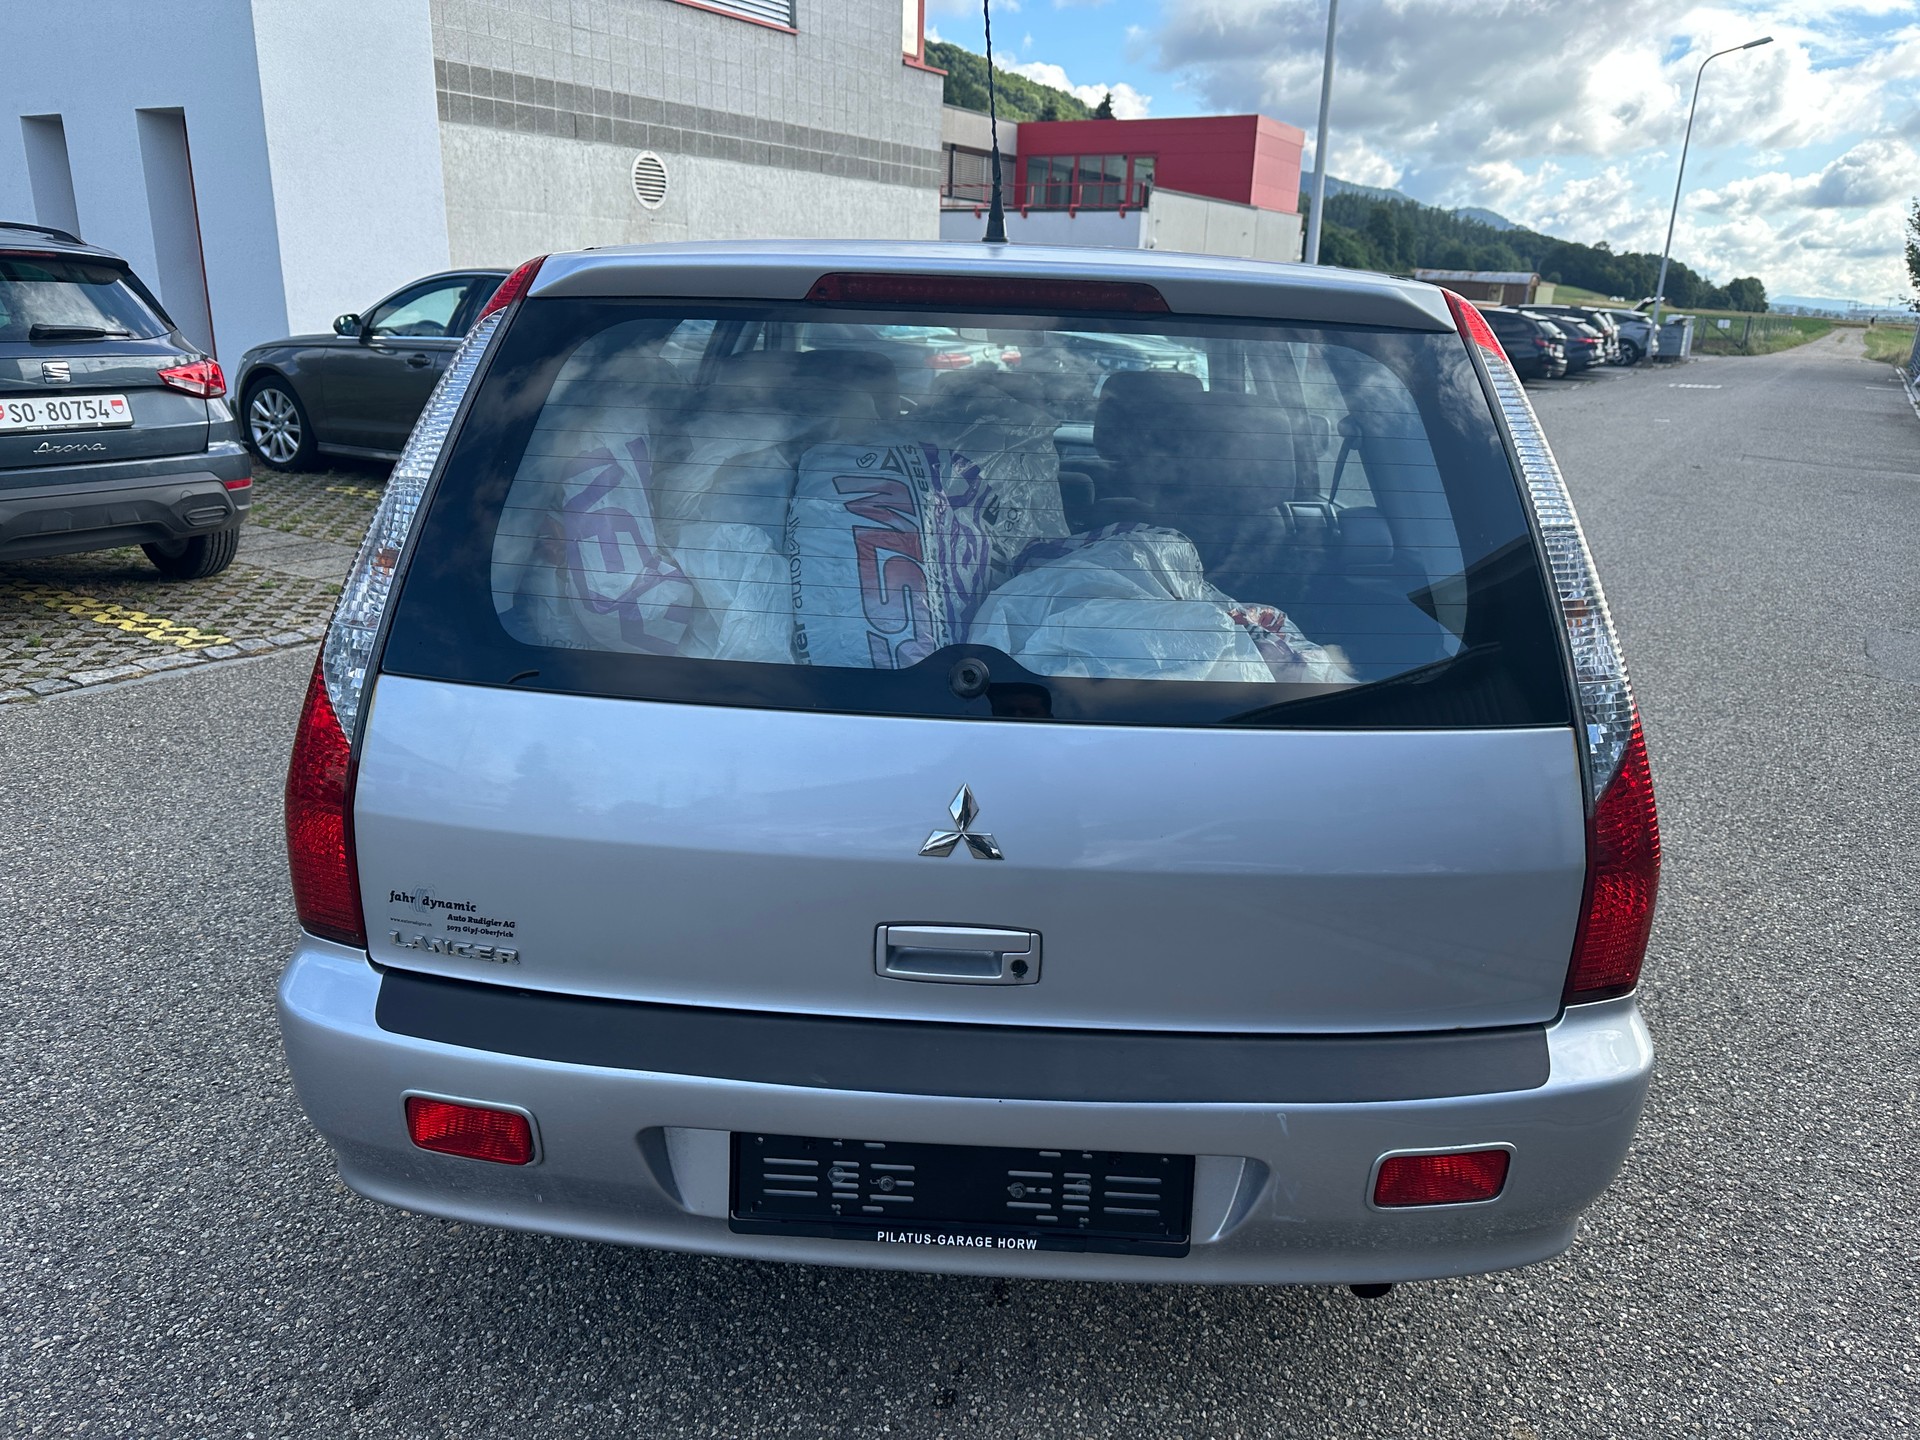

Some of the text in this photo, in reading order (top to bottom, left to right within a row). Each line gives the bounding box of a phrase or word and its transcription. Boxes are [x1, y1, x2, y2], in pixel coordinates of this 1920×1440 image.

[33, 441, 107, 454] Arona
[389, 890, 477, 912] fahr dynamic
[447, 913, 466, 923] Auto
[503, 920, 516, 928] AG
[447, 924, 514, 938] 5073 Gipf-Oberfrick
[389, 930, 521, 965] LANCER
[877, 1231, 1037, 1250] PILATUS-GARAGE HORW
